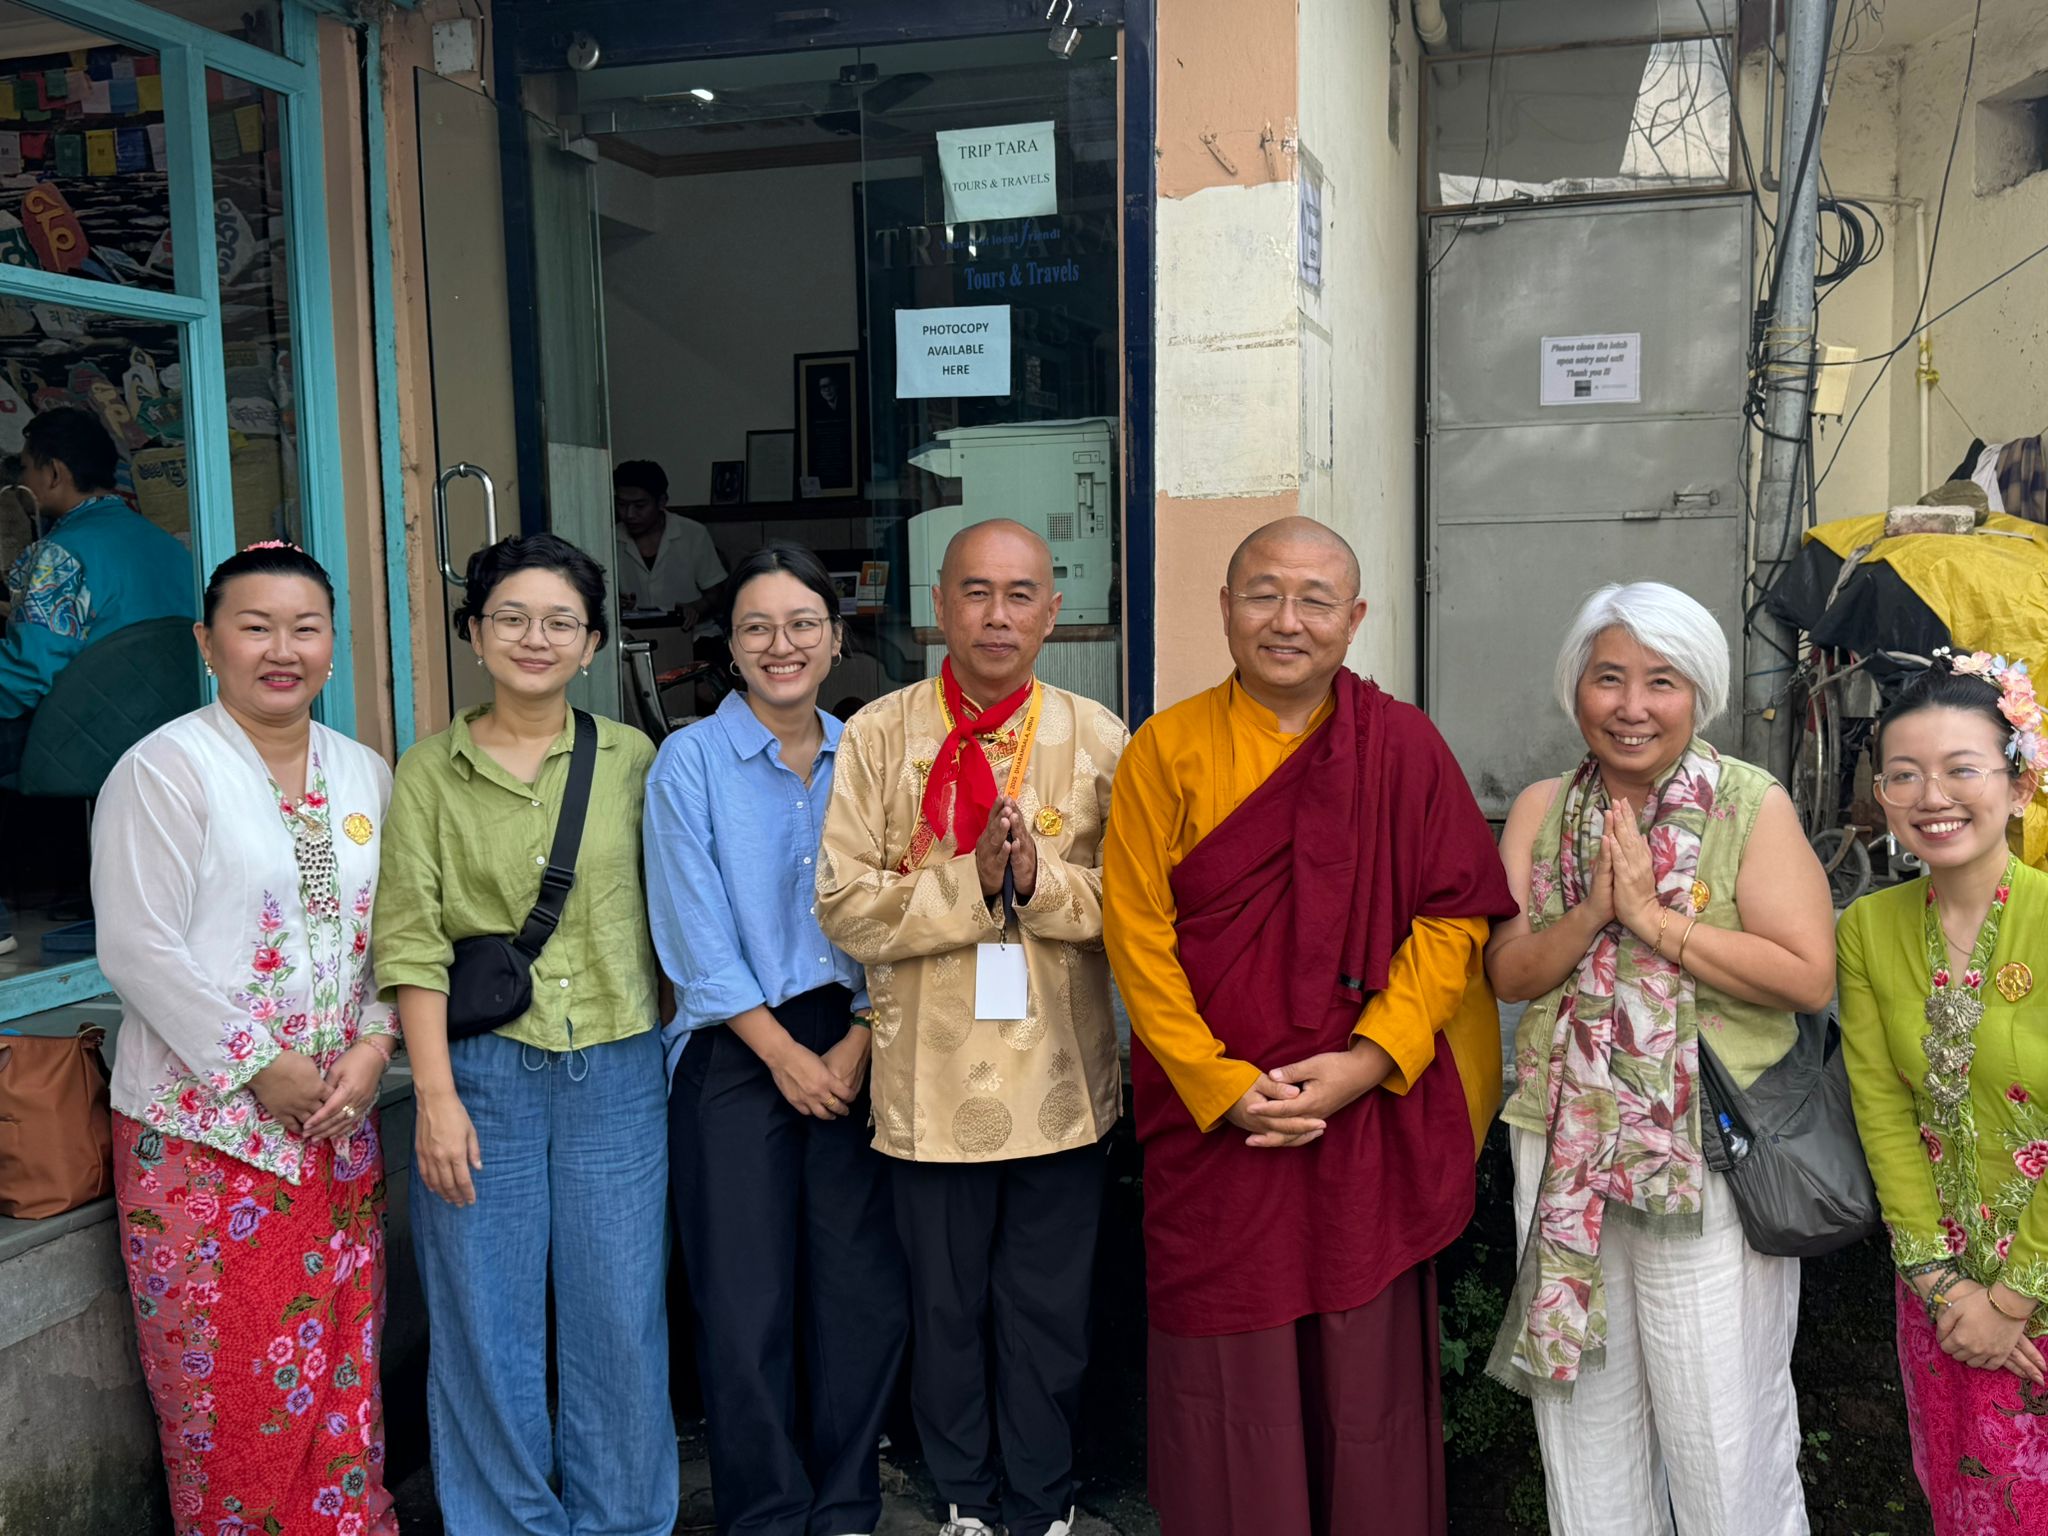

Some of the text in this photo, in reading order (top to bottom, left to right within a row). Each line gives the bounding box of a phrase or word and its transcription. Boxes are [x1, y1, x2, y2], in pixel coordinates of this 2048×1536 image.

[958, 139, 1039, 160] TRIP TARA
[952, 173, 1051, 193] TOURS & TRAVELS
[964, 258, 1080, 290] Tours & Travels
[922, 322, 990, 336] PHOTOCOPY
[927, 343, 985, 357] AVAILABLE
[1551, 344, 1575, 352] Please
[1576, 343, 1595, 351] close
[1596, 342, 1608, 350] the
[1575, 355, 1594, 365] entry
[1595, 354, 1609, 363] and
[942, 364, 970, 376] HERE
[1566, 369, 1587, 378] Thank
[1588, 370, 1602, 378] you
[1010, 777, 1018, 790] 2025
[1026, 716, 1035, 732] INDIA
